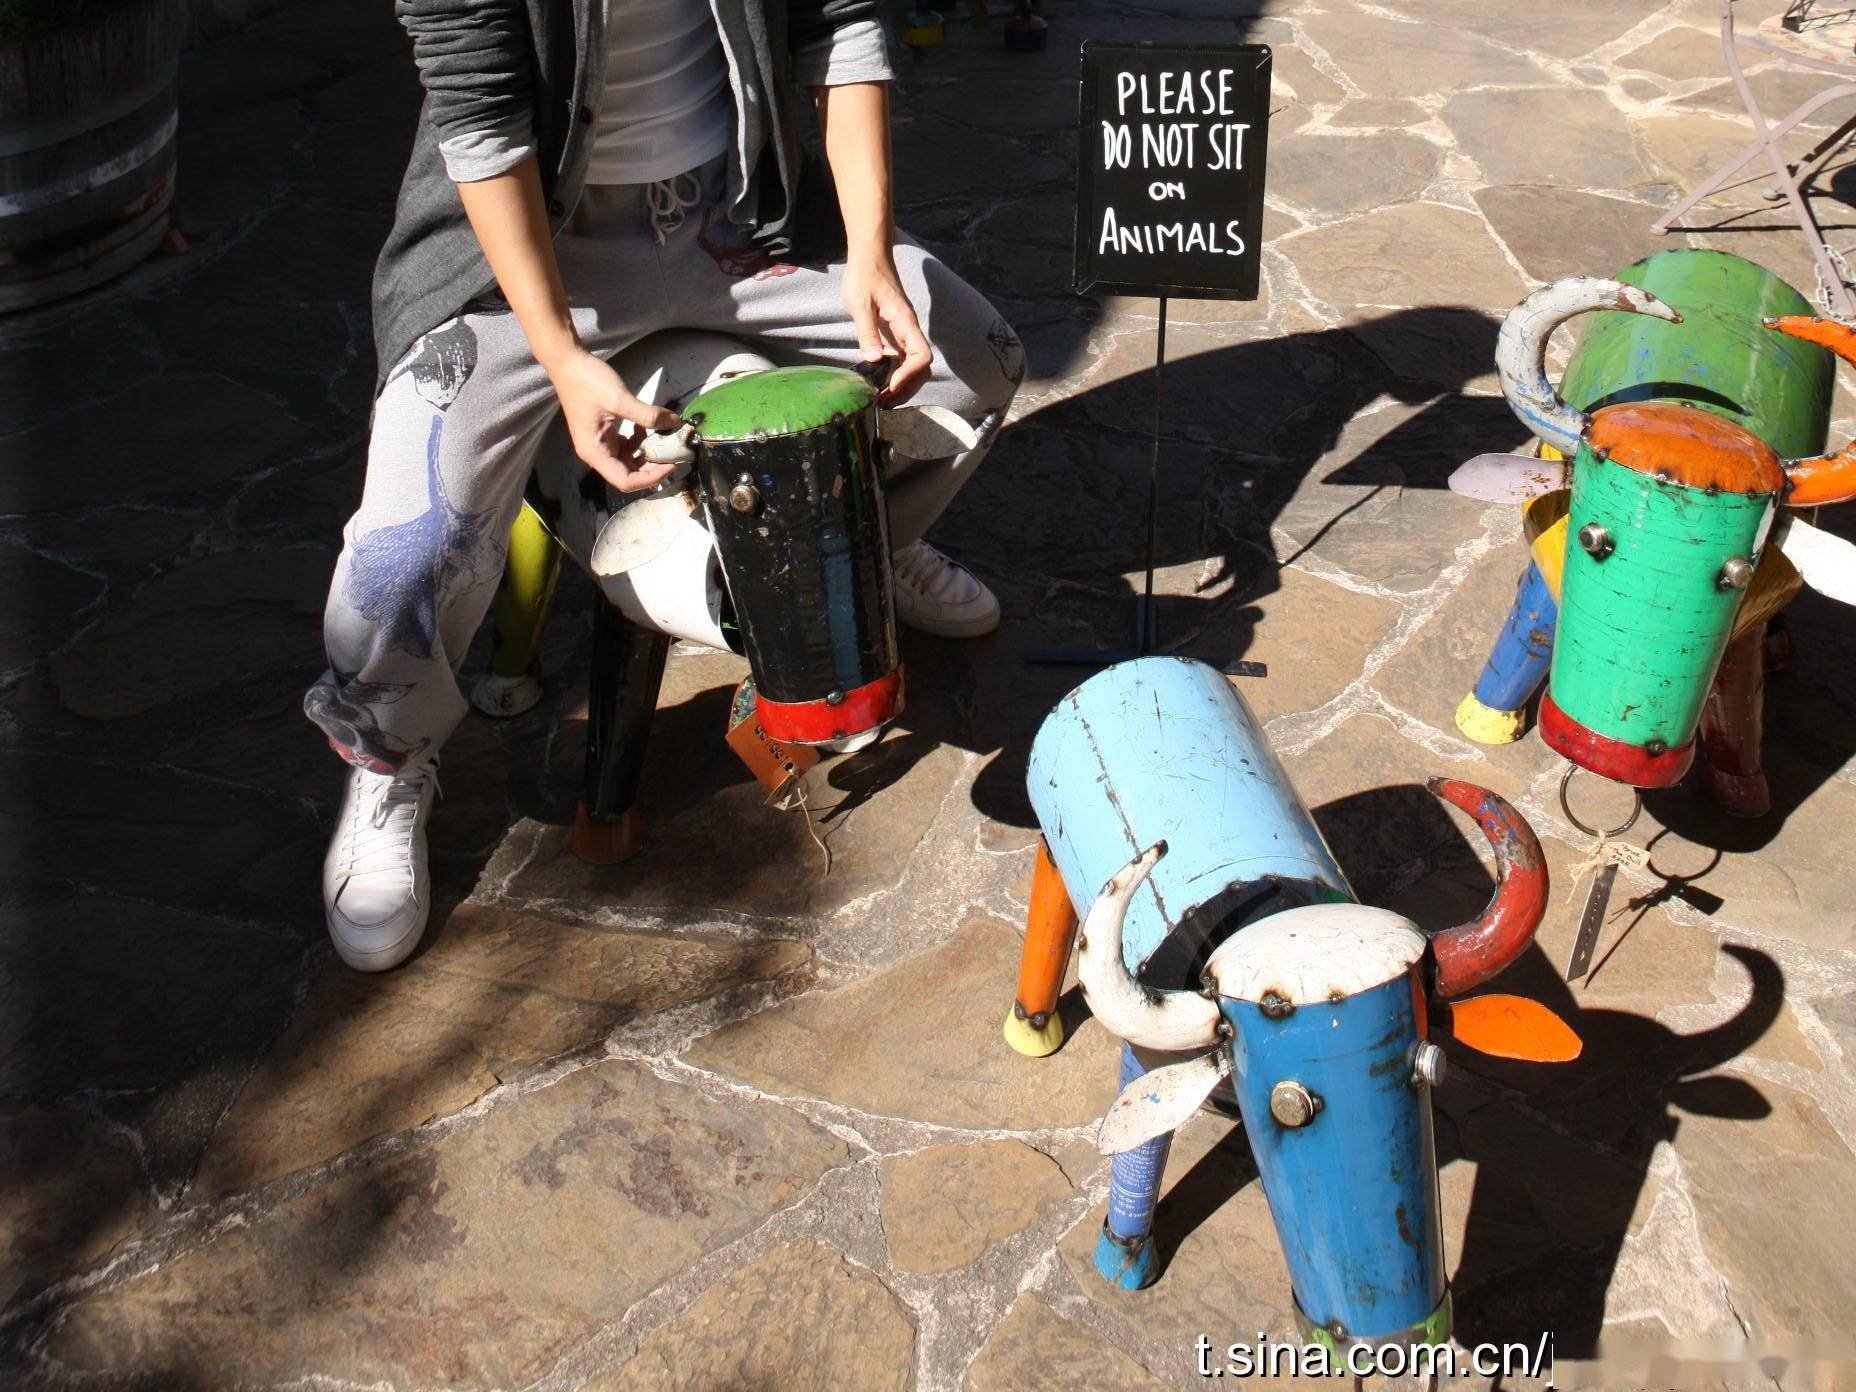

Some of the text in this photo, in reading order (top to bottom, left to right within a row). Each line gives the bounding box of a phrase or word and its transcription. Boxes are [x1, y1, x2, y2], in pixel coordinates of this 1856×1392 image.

[1117, 69, 1235, 116] PLEASE
[1101, 120, 1251, 171] DO NOT SIT
[1148, 181, 1186, 201] ON
[1099, 207, 1246, 257] ANIMALS
